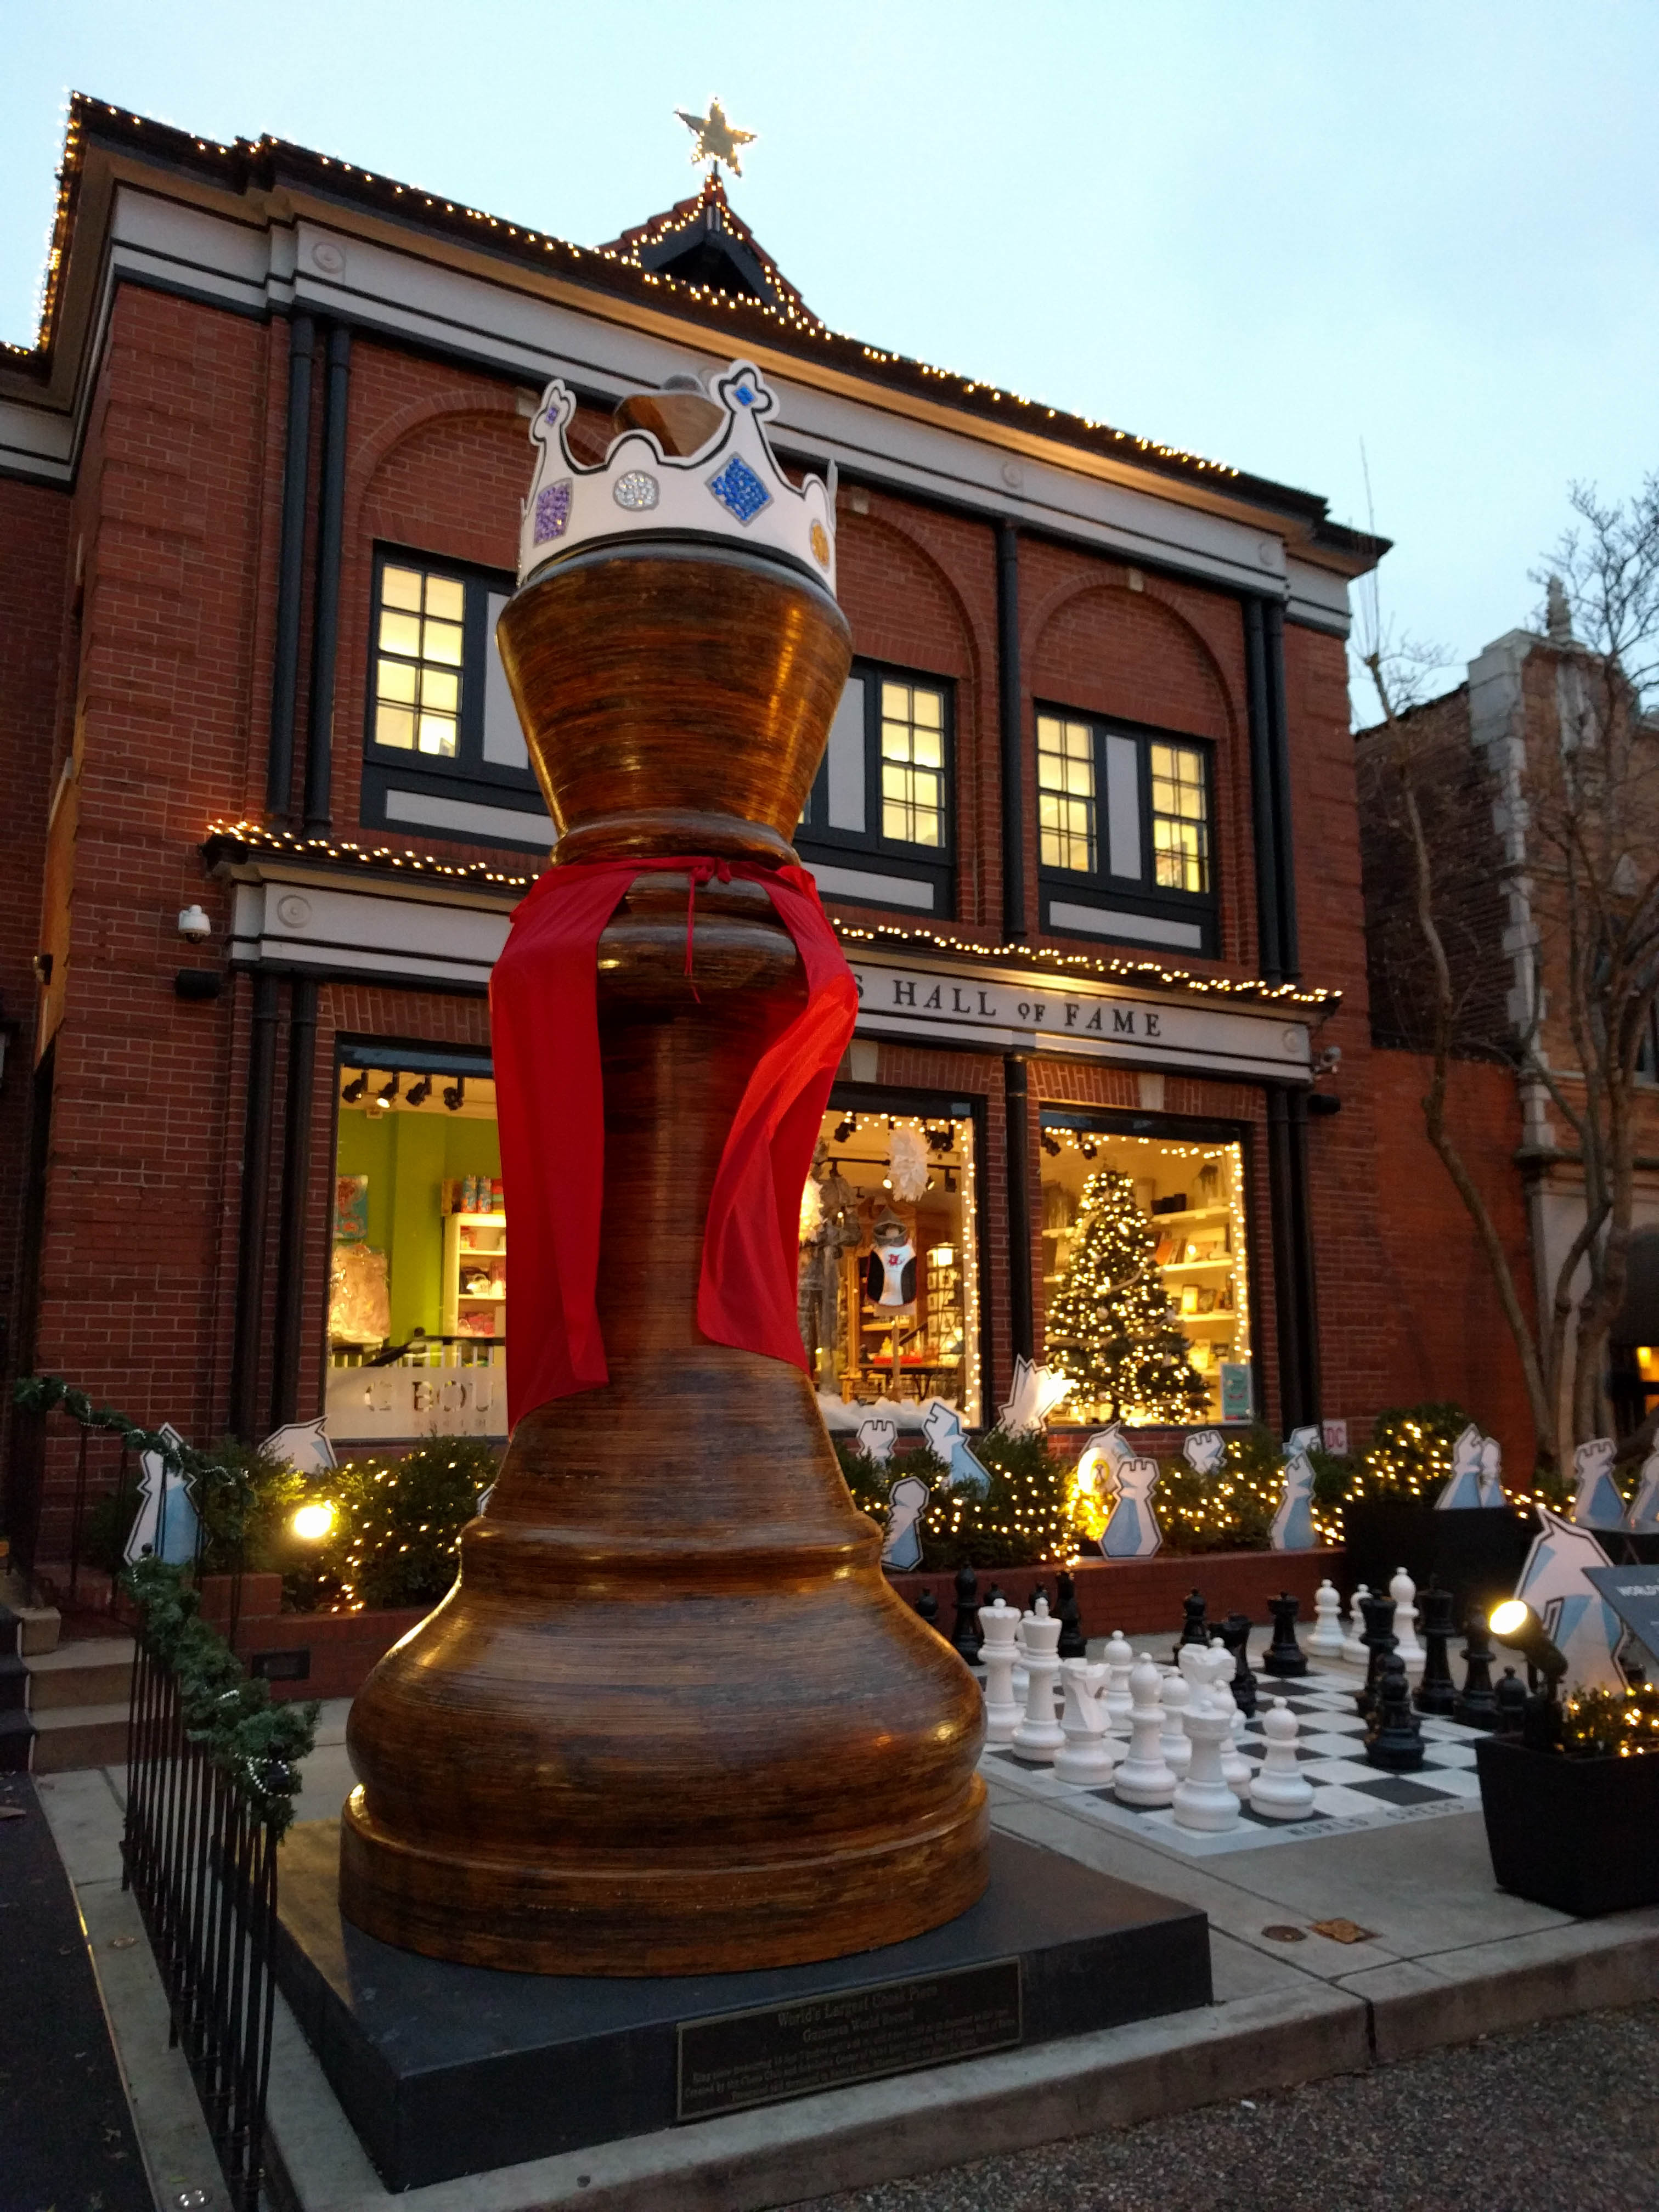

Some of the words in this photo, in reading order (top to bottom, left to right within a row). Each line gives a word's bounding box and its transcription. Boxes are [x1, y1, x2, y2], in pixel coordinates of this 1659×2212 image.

[893, 979, 996, 1016] HALL
[1018, 1002, 1046, 1023] OF
[1064, 1002, 1161, 1037] FAME
